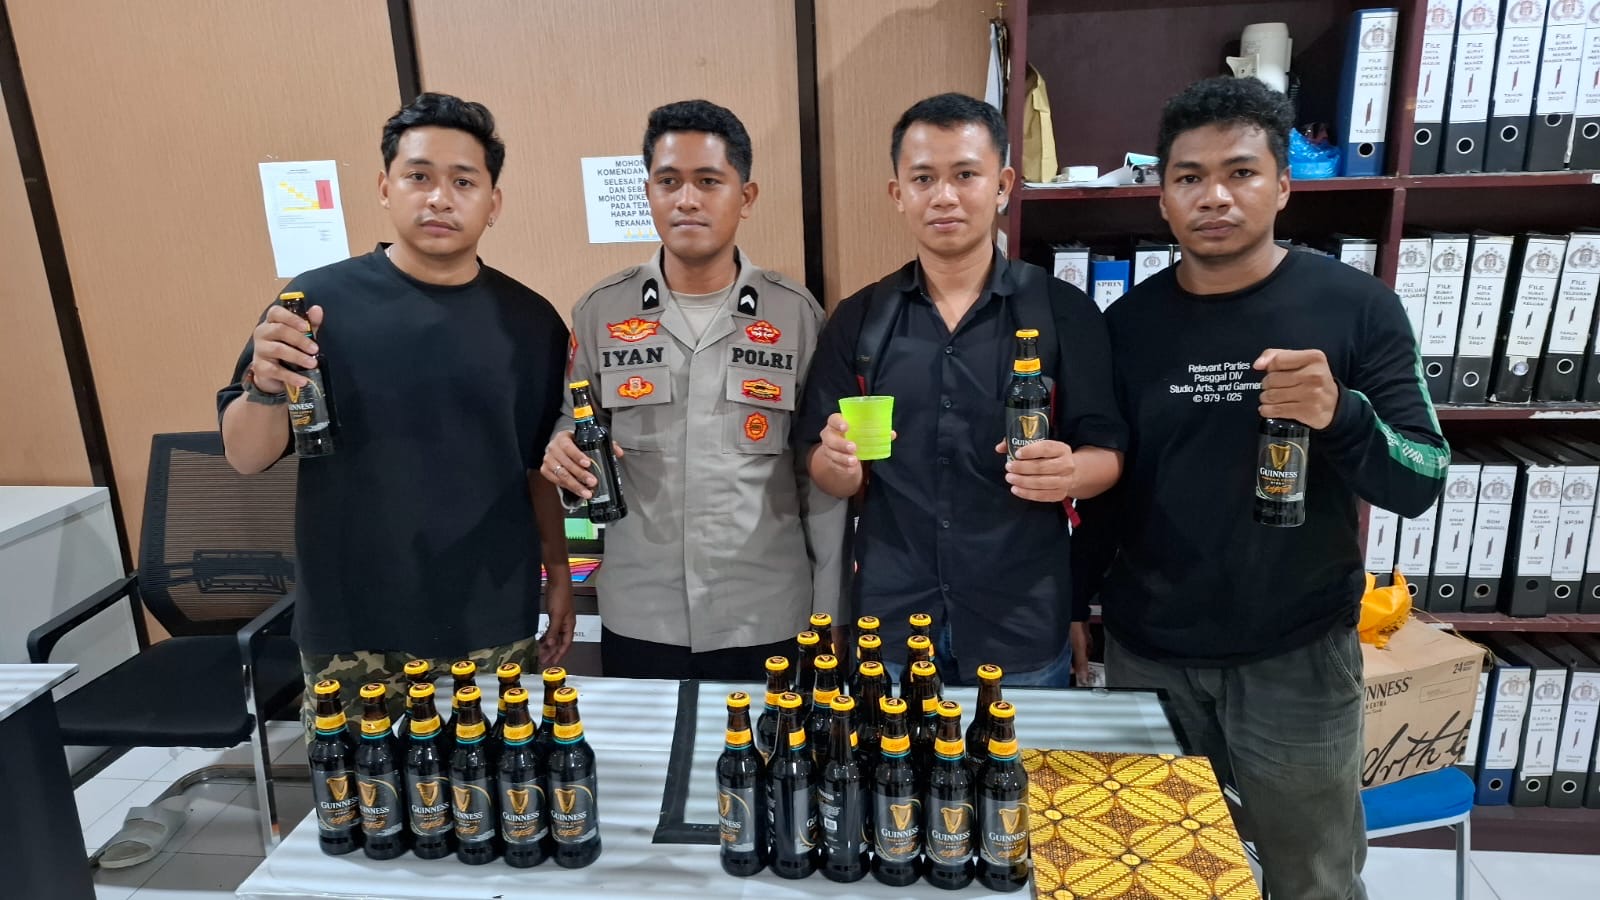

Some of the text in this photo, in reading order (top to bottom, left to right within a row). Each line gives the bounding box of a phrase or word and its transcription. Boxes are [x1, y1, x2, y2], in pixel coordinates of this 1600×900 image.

[597, 168, 644, 176] KOMENDAN
[604, 178, 636, 186] SELESAI
[609, 186, 625, 194] DAN
[598, 193, 647, 202] MOHON DIKE
[611, 201, 649, 210] PADA TEM
[610, 209, 650, 218] HARAP MA
[614, 219, 651, 227] REKANAN
[602, 346, 664, 367] IYAN
[731, 347, 793, 370] POLRI
[1188, 361, 1251, 373] Relevant Parties
[1228, 371, 1244, 380] DIV
[1169, 384, 1194, 393] Studio
[1195, 383, 1215, 393] Arts,
[1217, 382, 1232, 390] and
[1203, 393, 1220, 402] 979
[1226, 392, 1242, 401] 025
[1259, 467, 1298, 478] GUINNESS
[1452, 662, 1463, 674] 24
[411, 802, 450, 814] GUINNESS
[502, 810, 540, 821] GUINNESS
[550, 810, 587, 821] GUINNESS
[881, 825, 919, 838] GUINNESS
[931, 829, 970, 841] GUINNESS
[988, 829, 1027, 841] GUINNESS
